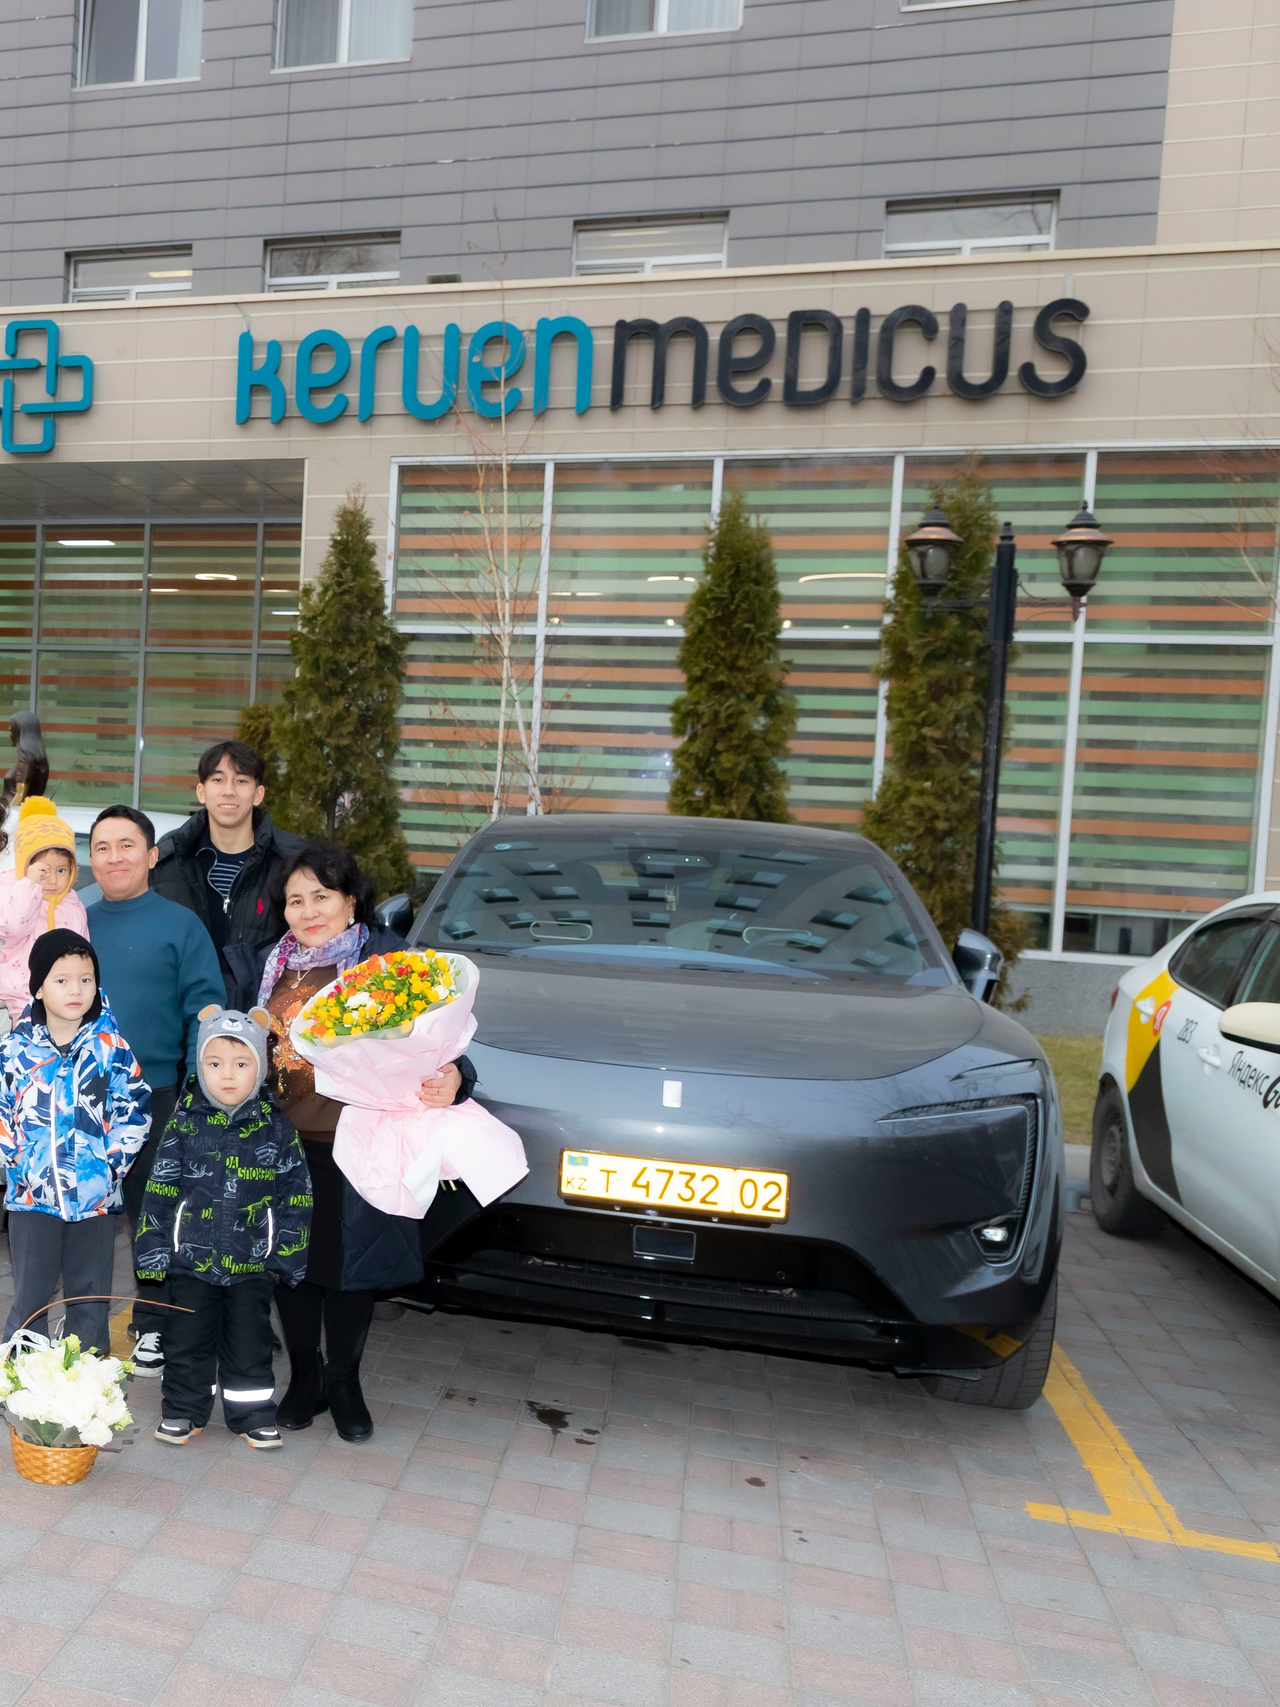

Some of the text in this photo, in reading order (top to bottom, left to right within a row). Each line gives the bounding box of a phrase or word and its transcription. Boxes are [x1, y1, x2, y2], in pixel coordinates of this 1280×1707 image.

[1228, 1050, 1270, 1096] Яндекс
[566, 1176, 587, 1191] KZ
[600, 1167, 782, 1213] T 4732 02
